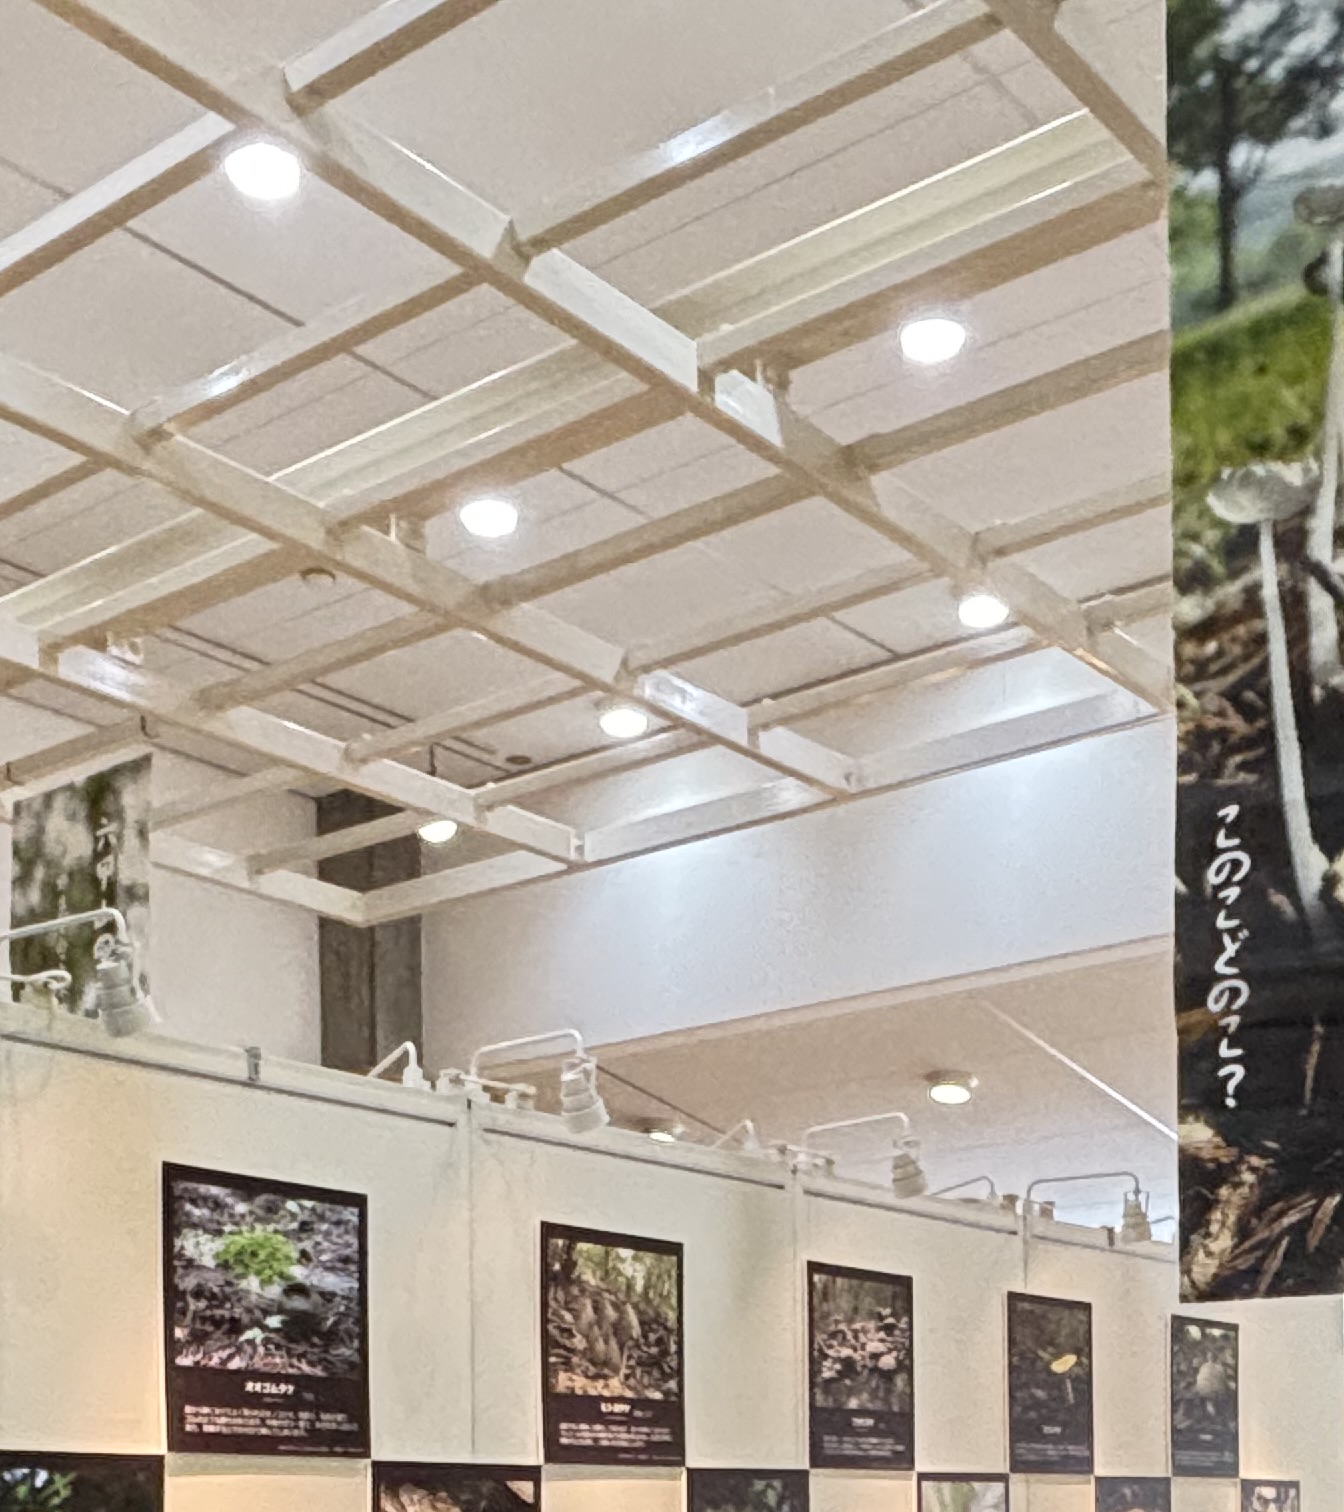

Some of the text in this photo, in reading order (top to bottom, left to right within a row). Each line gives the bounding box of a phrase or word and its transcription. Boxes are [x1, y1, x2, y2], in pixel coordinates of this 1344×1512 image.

[1206, 804, 1252, 1108] このこどのこ?
